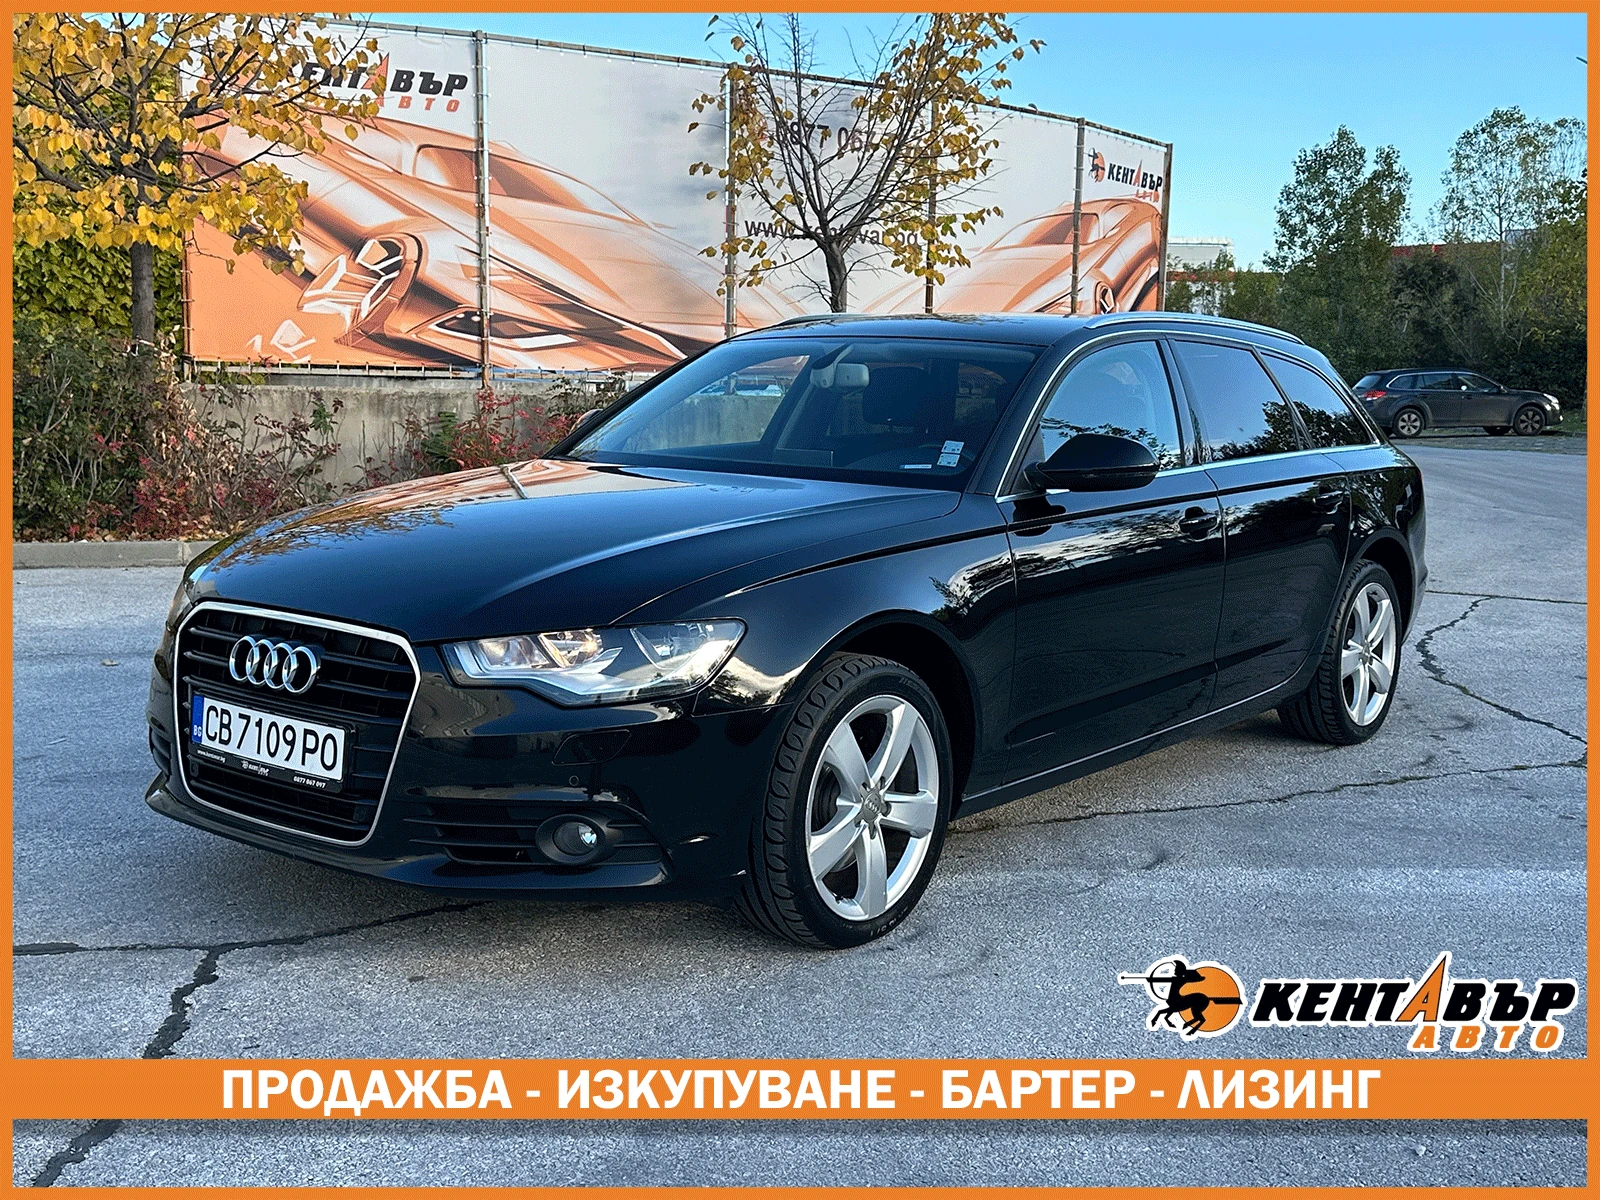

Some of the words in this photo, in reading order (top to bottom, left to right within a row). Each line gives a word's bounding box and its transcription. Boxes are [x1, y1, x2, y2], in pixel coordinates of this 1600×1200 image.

[288, 52, 468, 97] ЕНТАВЪР
[1107, 160, 1163, 192] КЕНТАВЪР
[193, 724, 203, 737] BG
